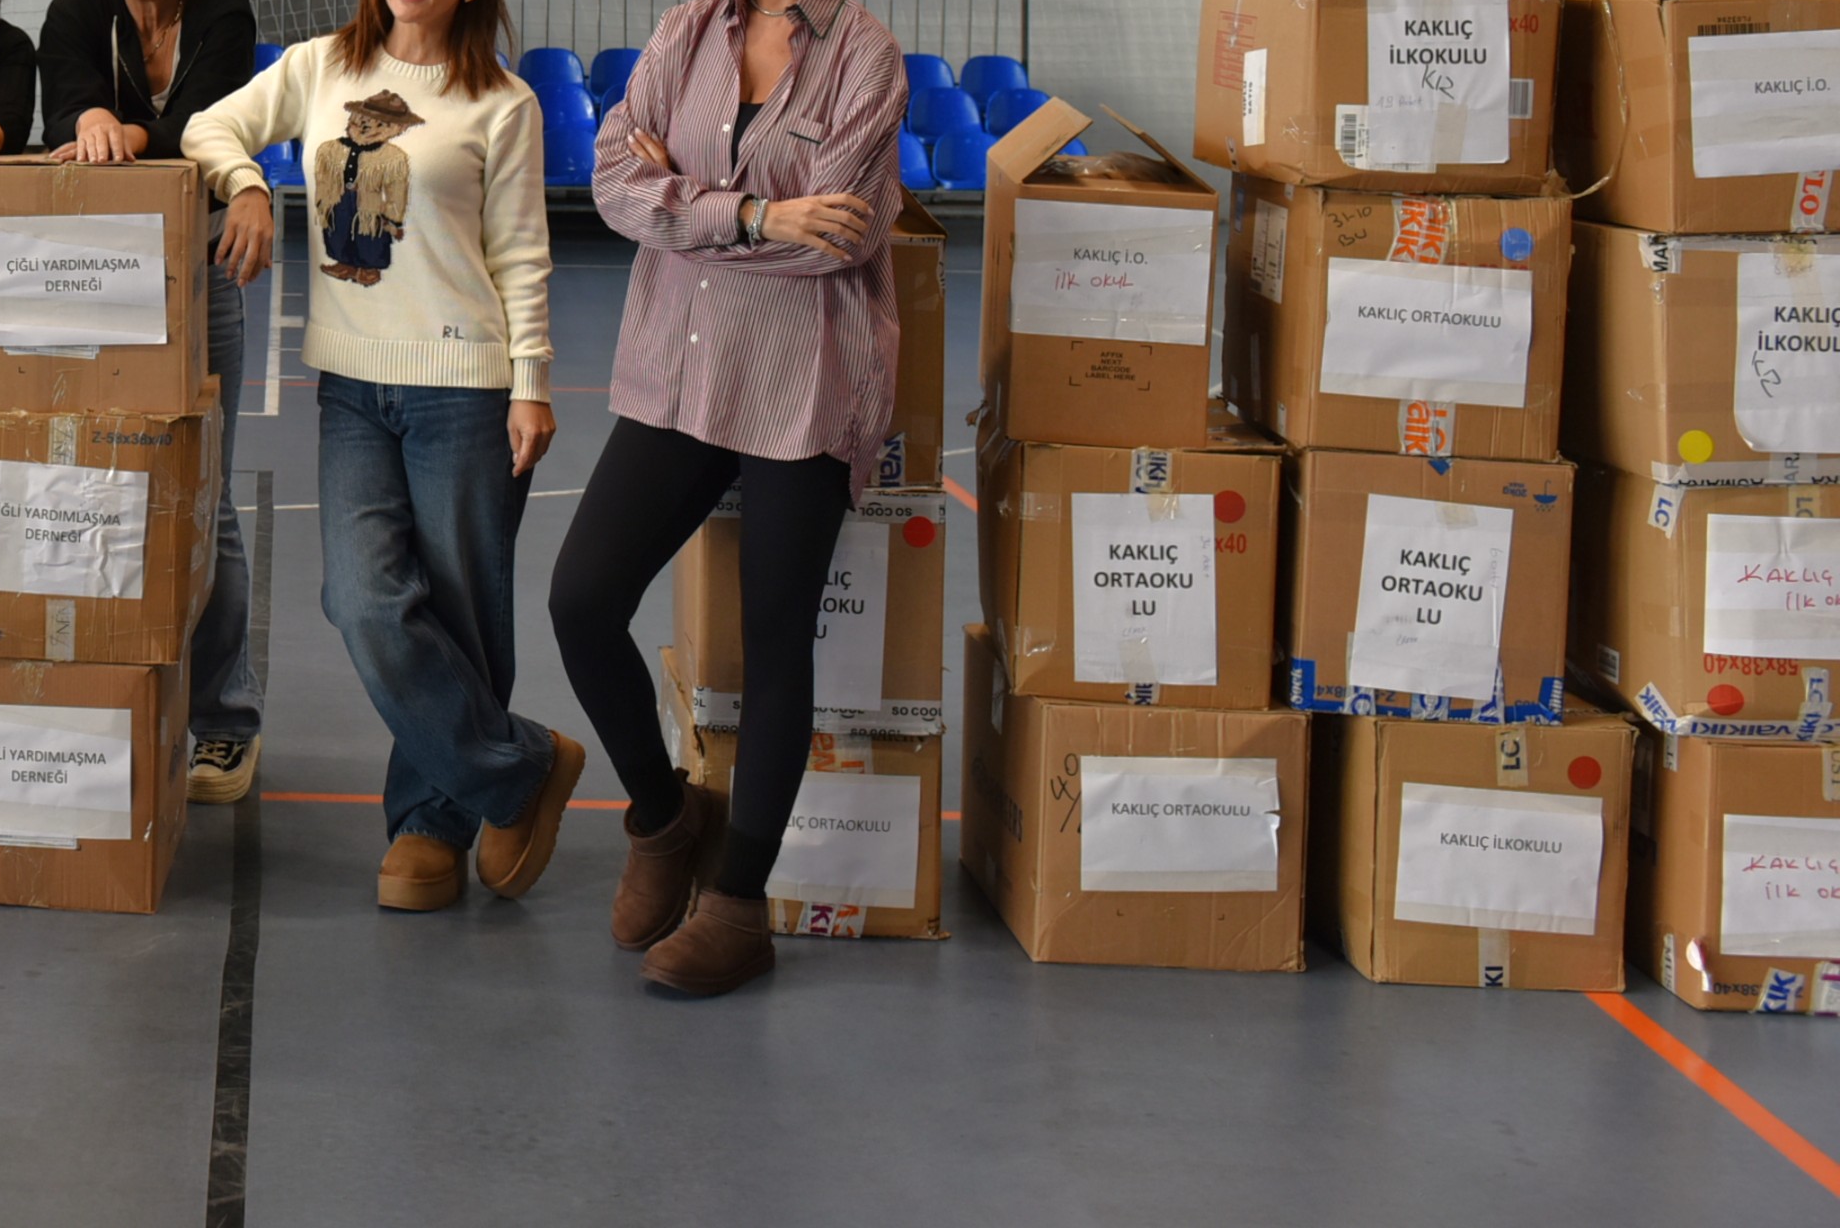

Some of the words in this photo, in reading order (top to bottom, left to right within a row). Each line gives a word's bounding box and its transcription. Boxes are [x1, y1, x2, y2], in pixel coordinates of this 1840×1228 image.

[1404, 20, 1473, 40] KAKLIÇ
[1389, 44, 1488, 65] İLKOKULU
[1754, 79, 1804, 95] KAKLIÇ
[1806, 76, 1831, 92] İ.O.
[1073, 247, 1122, 264] KAKLIÇ
[1124, 248, 1149, 265] İ.O.
[6, 257, 39, 274] ÇİĞLİ
[42, 257, 140, 273] YARDIMLAŞMA
[44, 276, 102, 292] DERNEĞİ
[1358, 305, 1408, 323] KAKLIÇ
[1411, 310, 1502, 328] ORTAOKULU
[1085, 372, 1111, 380] LABEL
[1113, 373, 1136, 381] HERE
[1091, 364, 1131, 373] BARCODE
[24, 507, 122, 526] YARDIMLAŞMA
[858, 507, 893, 518] COOL
[895, 506, 913, 517] SO
[24, 527, 82, 544] DERNEĞİ
[1109, 544, 1179, 564] KAKLIÇ
[1399, 548, 1472, 576] KAKLIÇ
[1093, 571, 1194, 589] ORTAOKU
[1381, 575, 1483, 602] ORTAOKU
[1131, 600, 1157, 616] LU
[1416, 607, 1442, 625] LU
[891, 706, 909, 716] SO
[9, 749, 107, 766] YARDIMLAŞMA
[11, 769, 68, 784] DERNEĞİ
[1111, 802, 1160, 818] KAKLIÇ
[1162, 803, 1252, 817] ORTAOKULU
[808, 817, 892, 833] ORTAOKULU
[1440, 832, 1490, 851] KAKLIÇ
[1492, 834, 1563, 854] İLKOKULU
